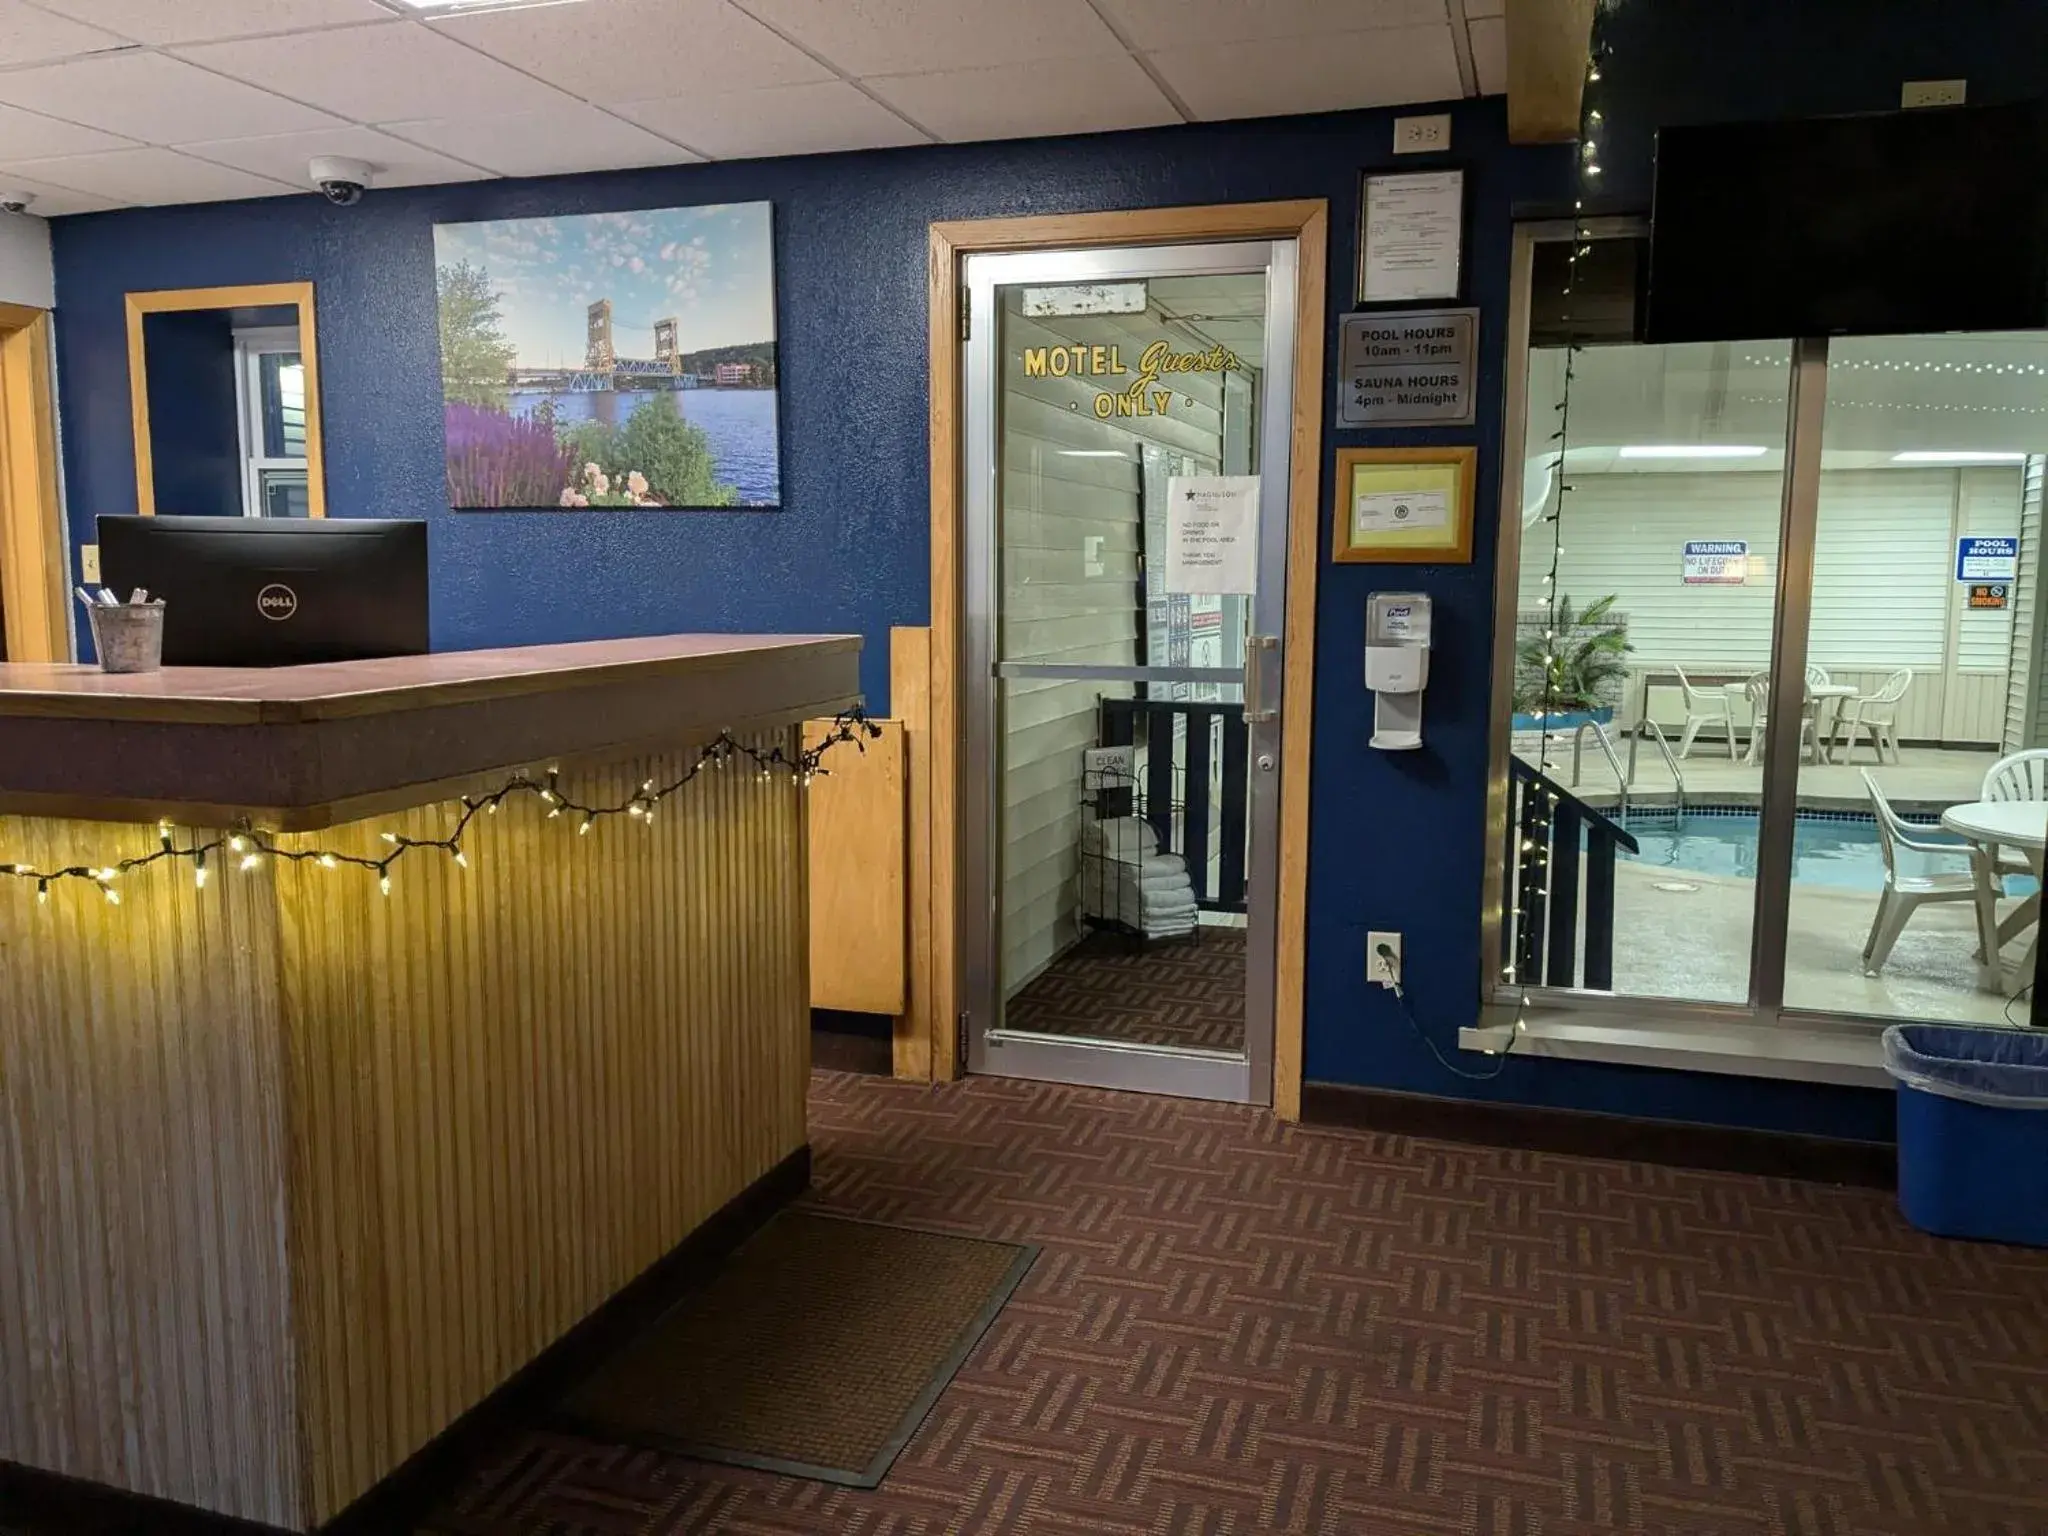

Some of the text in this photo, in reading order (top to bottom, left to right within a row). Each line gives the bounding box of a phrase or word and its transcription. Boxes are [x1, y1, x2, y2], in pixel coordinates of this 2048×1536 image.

[1361, 327, 1456, 341] POOL HOURS
[1364, 345, 1400, 357] 10am
[1413, 343, 1453, 356] 11pm
[1024, 340, 1241, 398] MOTEL Guests
[1354, 375, 1460, 389] SAUNA HOURS
[1094, 391, 1174, 418] ONLY
[1354, 396, 1384, 408] 4pm
[1397, 392, 1458, 407] Midnight
[1690, 543, 1742, 553] WARNING
[1968, 547, 2014, 555] HOURS
[262, 597, 293, 607] DELL
